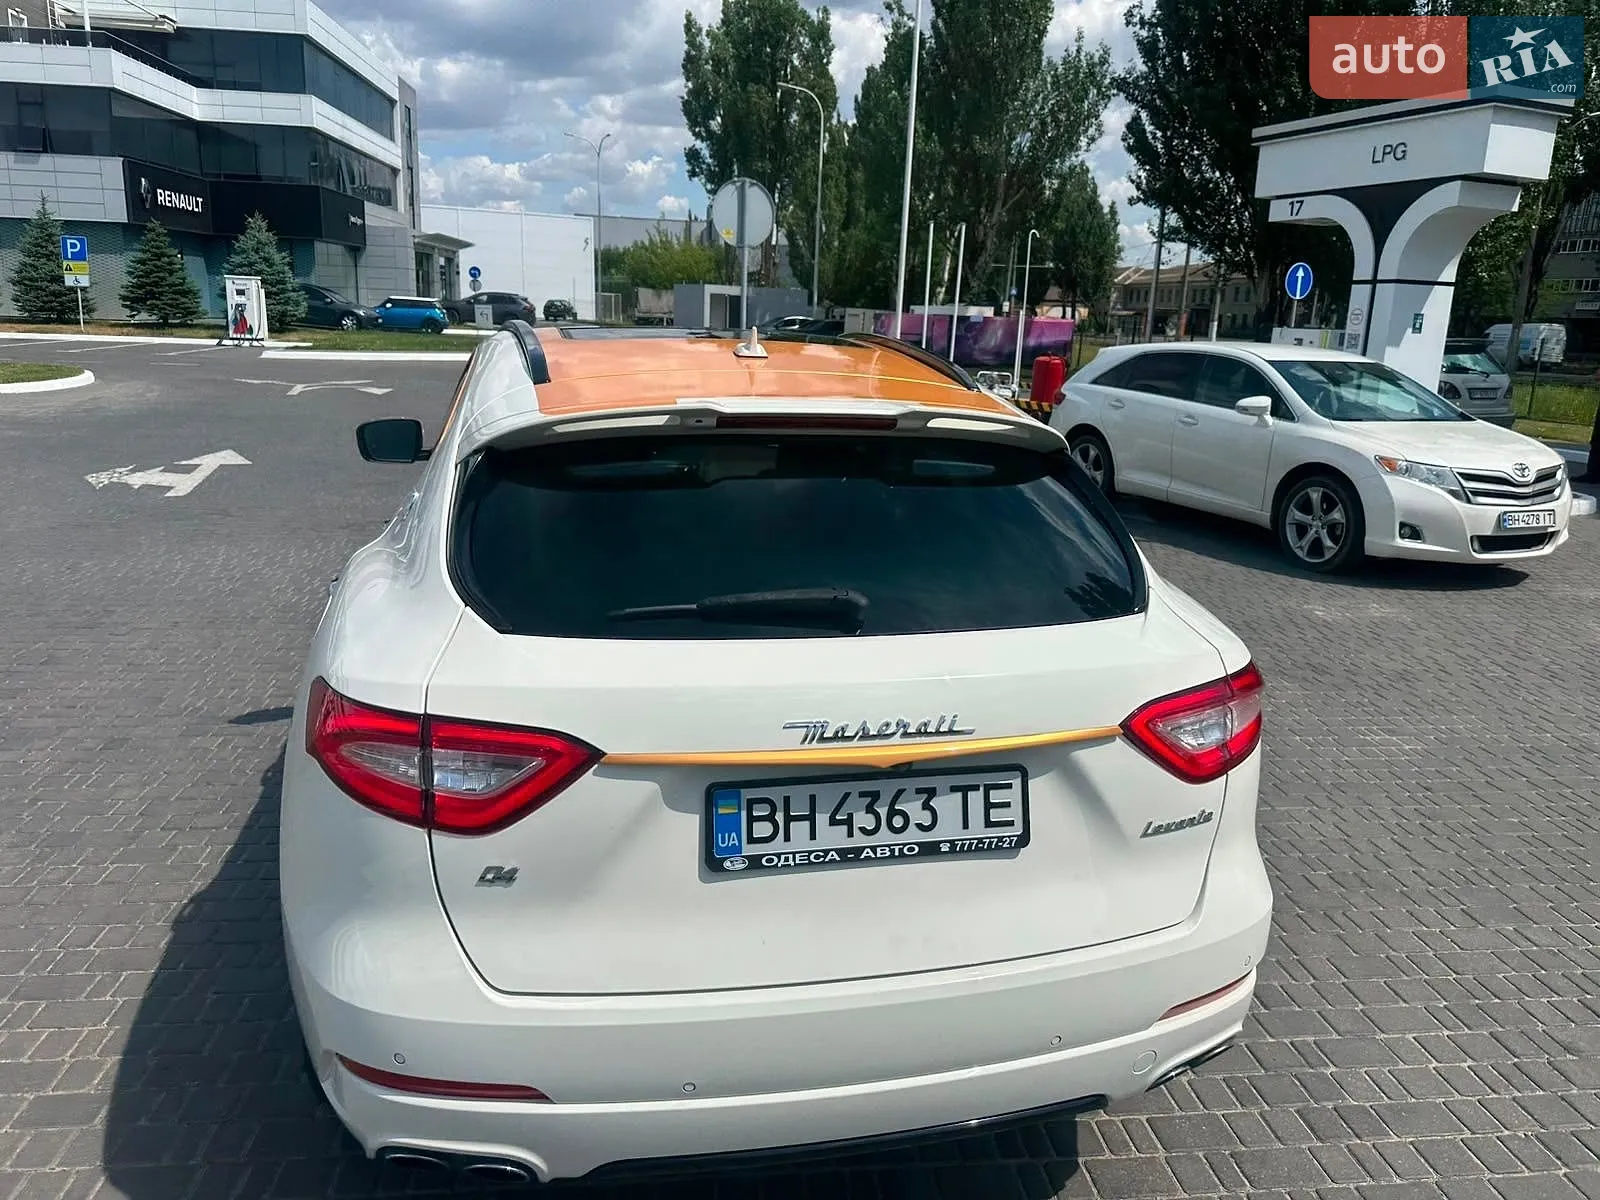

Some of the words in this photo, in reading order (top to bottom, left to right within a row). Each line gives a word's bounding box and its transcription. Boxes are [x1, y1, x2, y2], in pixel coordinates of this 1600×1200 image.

[1371, 142, 1408, 165] LPG
[156, 188, 204, 213] RENAULT
[1288, 200, 1305, 217] 17
[66, 239, 81, 259] P
[1507, 514, 1520, 526] BH
[1521, 513, 1541, 525] 4278
[782, 713, 976, 746] Maserati
[745, 793, 817, 845] BH
[828, 786, 938, 839] 4363
[949, 781, 1015, 831] TE
[1139, 808, 1214, 839] Levante
[718, 831, 739, 847] UA
[954, 836, 1018, 852] 777-77-27
[761, 850, 841, 868] ОДЕСА
[859, 843, 919, 859] АВТО
[474, 865, 520, 888] Q4
